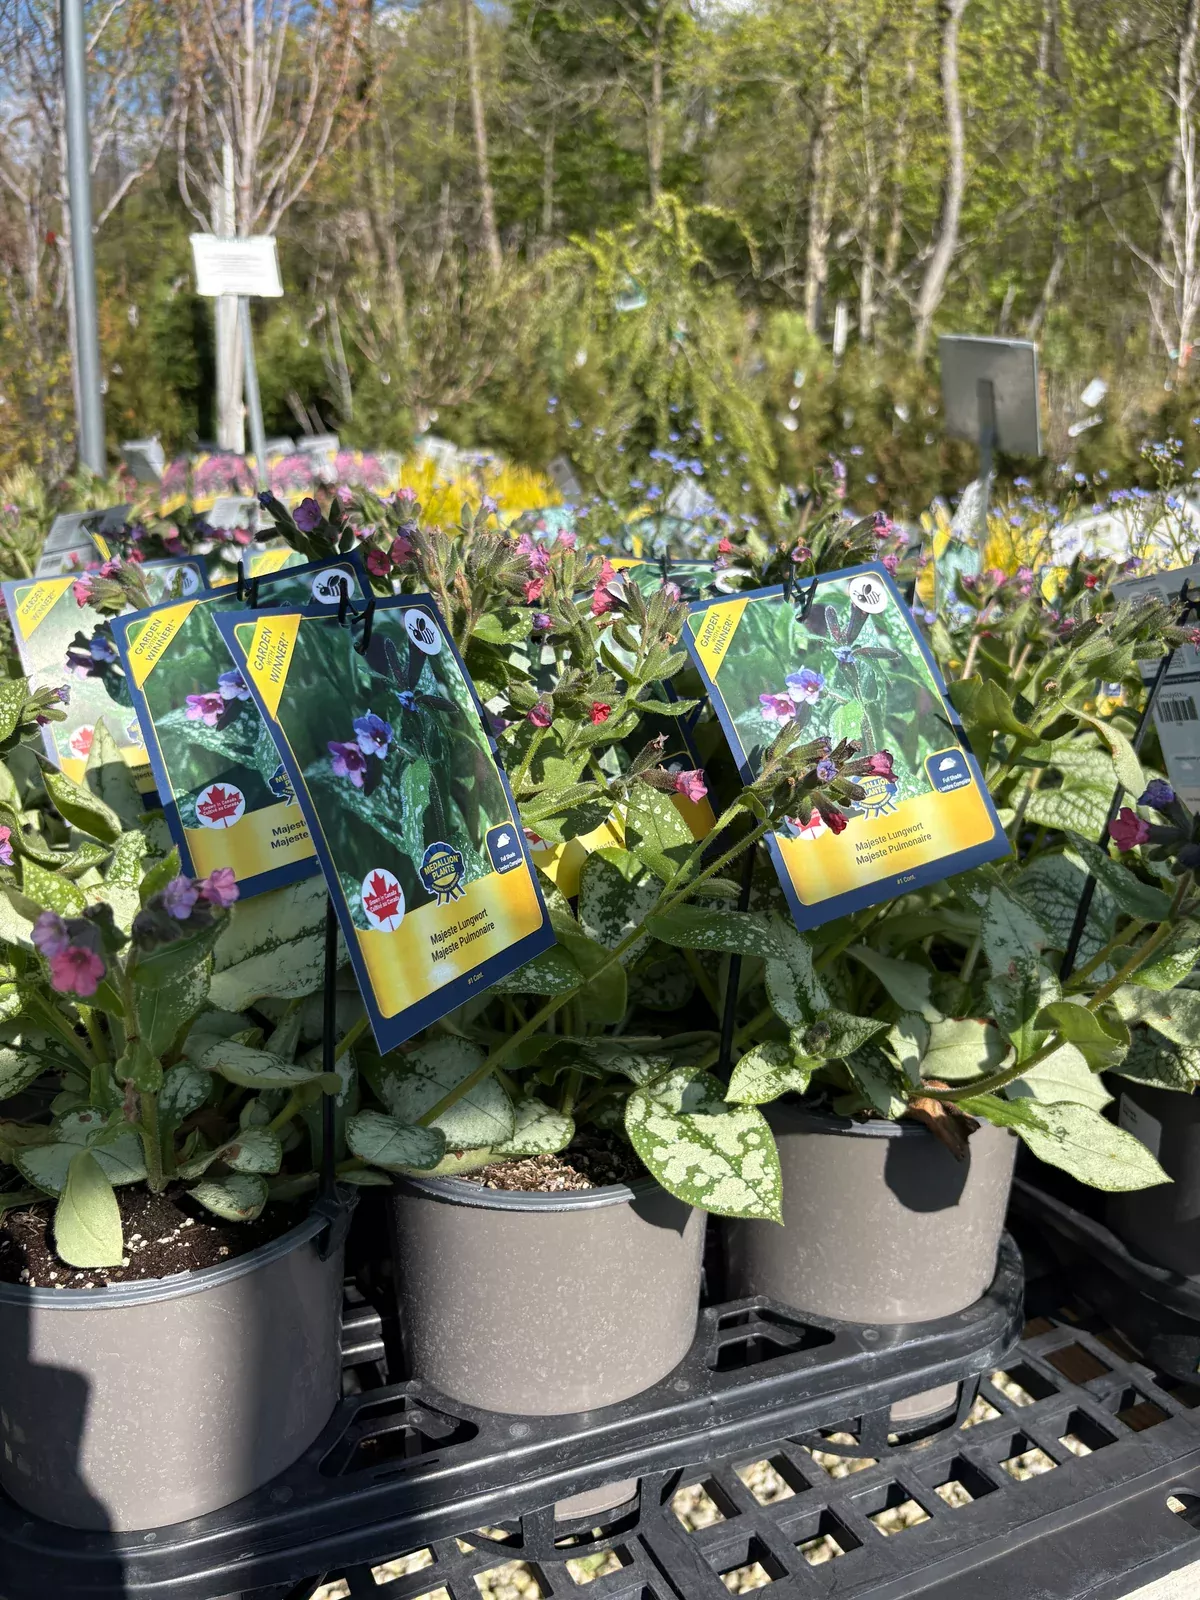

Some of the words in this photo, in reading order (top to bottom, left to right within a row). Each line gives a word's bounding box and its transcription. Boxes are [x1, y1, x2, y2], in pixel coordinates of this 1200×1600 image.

[134, 618, 163, 655] GARDEN
[700, 612, 720, 647] GARDEN
[253, 626, 273, 671] GARDEN
[265, 651, 275, 666] WITH
[864, 785, 887, 798] LANTS
[271, 832, 309, 849] Majeste
[855, 835, 887, 852] Majeste
[888, 822, 924, 841] Lungwort
[855, 848, 888, 865] Majeste
[888, 832, 932, 853] Pulmonaire
[423, 854, 461, 876] MEDALLION
[431, 864, 456, 880] PLANTS
[430, 925, 458, 946] Majeste
[457, 908, 488, 931] Lungwort
[431, 942, 460, 963] Majeste
[458, 921, 495, 947] Pulmonaire
